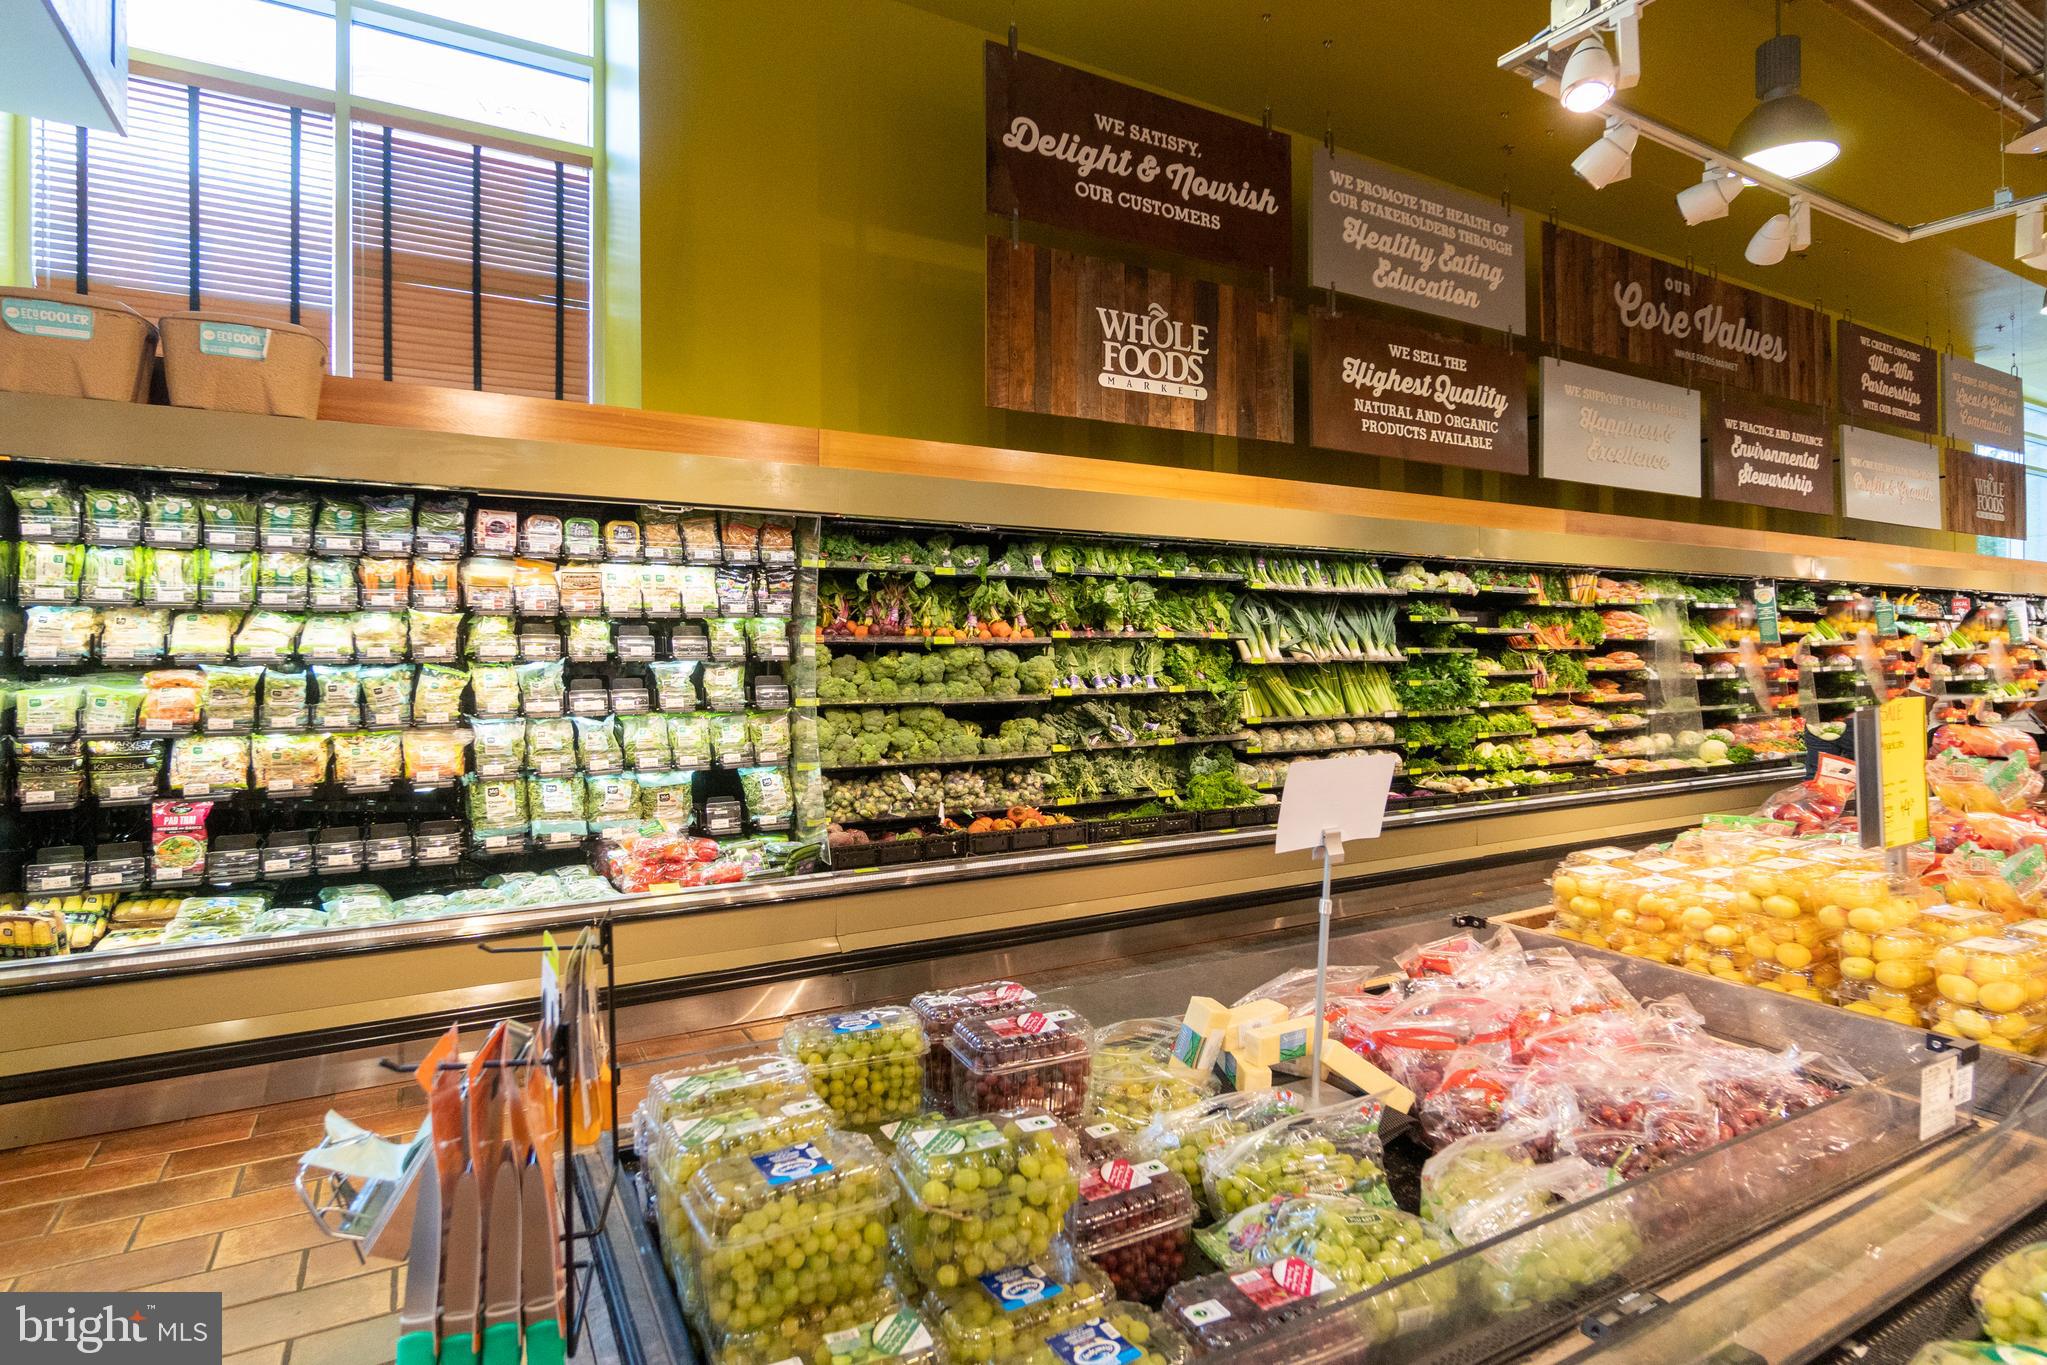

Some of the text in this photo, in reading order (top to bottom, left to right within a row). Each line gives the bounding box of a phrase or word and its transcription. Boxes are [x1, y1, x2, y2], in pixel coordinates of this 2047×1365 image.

[1094, 113, 1201, 158] WE SATISFY,
[1003, 116, 1278, 214] Delight & Nourish
[1075, 182, 1221, 230] OUR CUSTOMERS
[1330, 170, 1509, 238] WE PROMOTE THE HEALTH OF
[1329, 190, 1512, 256] OUR STAKEHOLDERS THROUGH
[1342, 216, 1504, 291] Healthy Eating
[1373, 257, 1480, 309] Education
[1665, 277, 1691, 297] OUR
[1096, 302, 1209, 355] WHOLE
[1614, 281, 1787, 363] Core Values
[1388, 344, 1467, 372] WE SELL THE
[1675, 349, 1738, 372] WHOLE FOODS MARKET
[1860, 335, 1871, 347] WE
[1871, 340, 1893, 354] CREATE
[1102, 341, 1204, 385] FOODS
[1868, 354, 1914, 381] Win-Win
[1107, 376, 1199, 397] MARKET
[1342, 357, 1508, 418] Highest Quality
[1564, 383, 1581, 397] WE
[1583, 388, 1624, 406] SUPPORT
[1861, 373, 1921, 407] Partnerships
[1354, 398, 1499, 433] NATURAL AND ORGANIC
[1580, 406, 1660, 442] Happiness
[1862, 399, 1920, 422] WITH OUR SUPPLIERS
[1361, 419, 1493, 450] PRODUCTS AVAILABLE
[1725, 418, 1824, 447] WE PRACTICE AND ADVANCE
[1587, 437, 1670, 471] Excellence
[1731, 434, 1820, 470] Environmental
[1738, 462, 1813, 496] Stewardship
[1974, 473, 2005, 498] WHOLE
[1977, 495, 2004, 513] FOODS
[116, 762, 145, 770] Salad
[163, 815, 196, 825] PAD THAI
